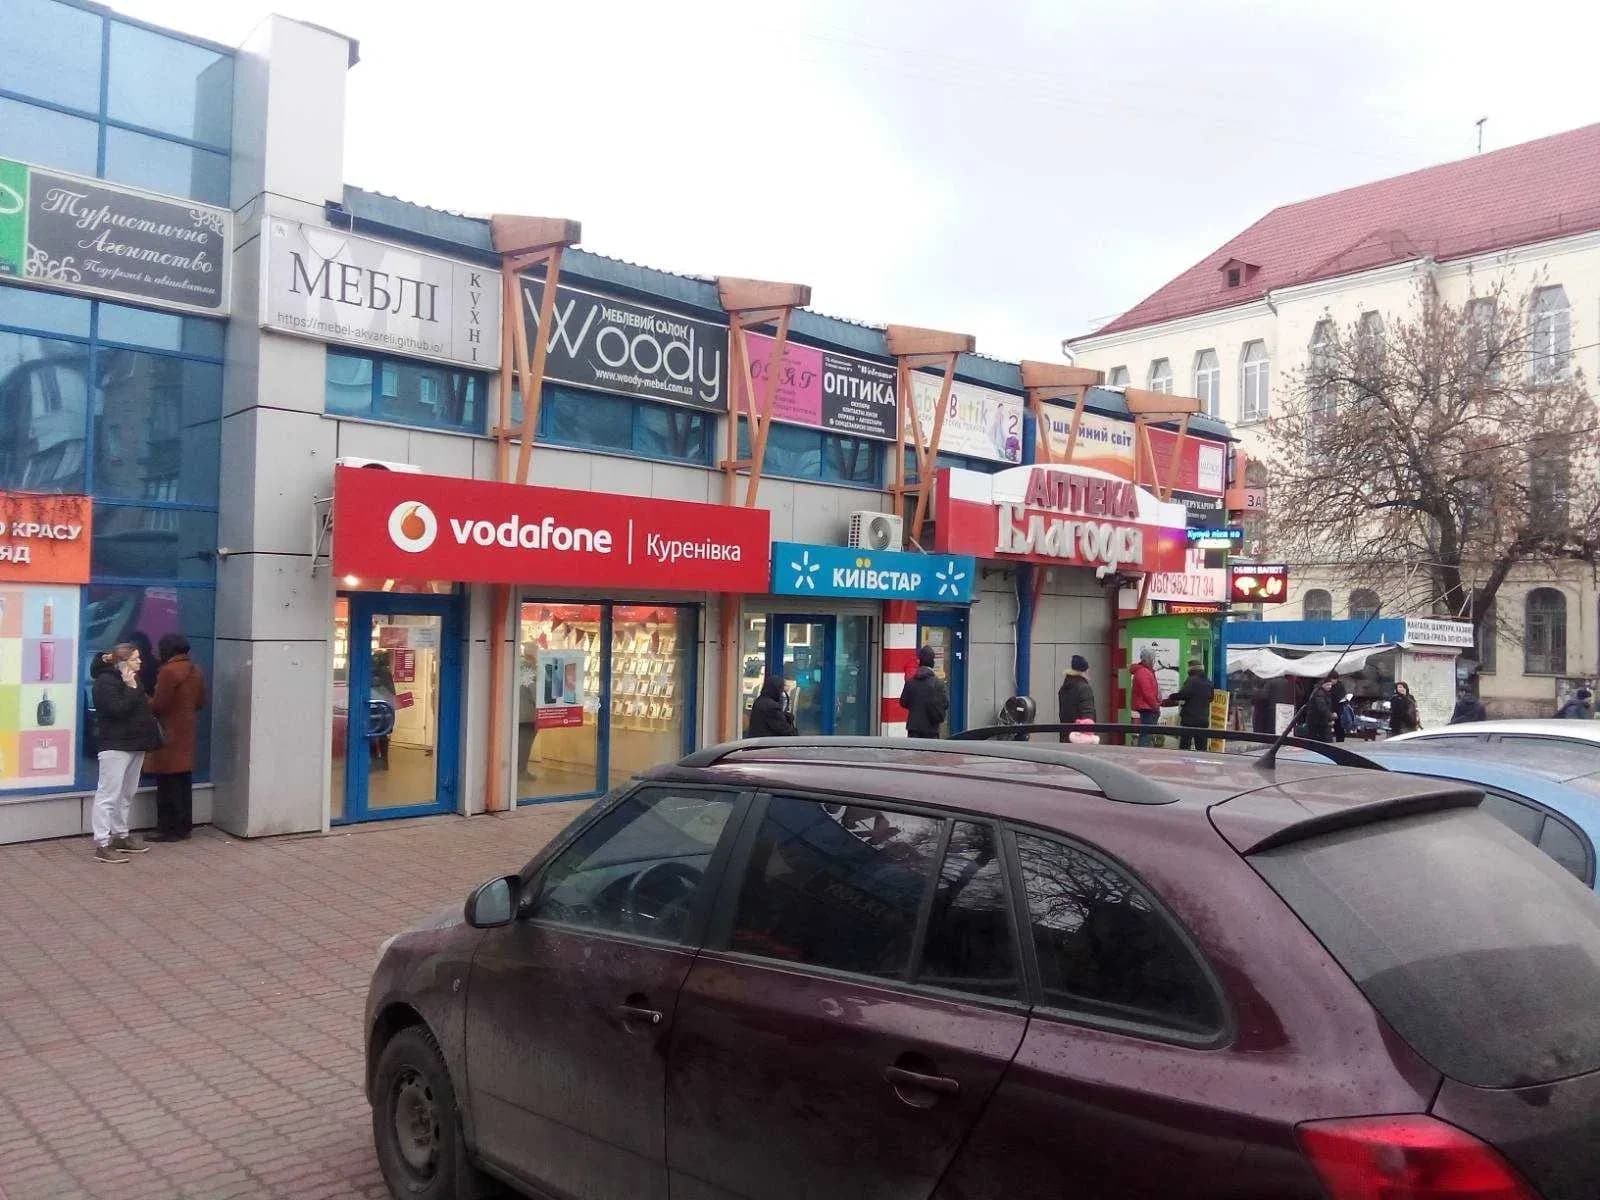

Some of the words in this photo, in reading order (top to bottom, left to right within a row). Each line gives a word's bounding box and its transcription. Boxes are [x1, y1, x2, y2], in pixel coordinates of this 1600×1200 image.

[41, 188, 208, 244] Туристичне
[78, 229, 213, 273] Агентство
[289, 251, 439, 323] МЕБЛІ
[470, 272, 481, 361] КУХНІ
[602, 308, 656, 332] МЕБЛЕВИЙ
[656, 319, 688, 340] САЛОН
[525, 287, 720, 402] Woody
[595, 369, 693, 396] www.woody-mebel.com.ua
[824, 372, 895, 406] ОПТИКА
[1025, 467, 1139, 519] АПТЕКА
[12, 522, 82, 540] КРАСУ
[450, 514, 612, 553] vodafone
[647, 533, 741, 563] Куренівка
[833, 557, 922, 591] КИЇВСТАР
